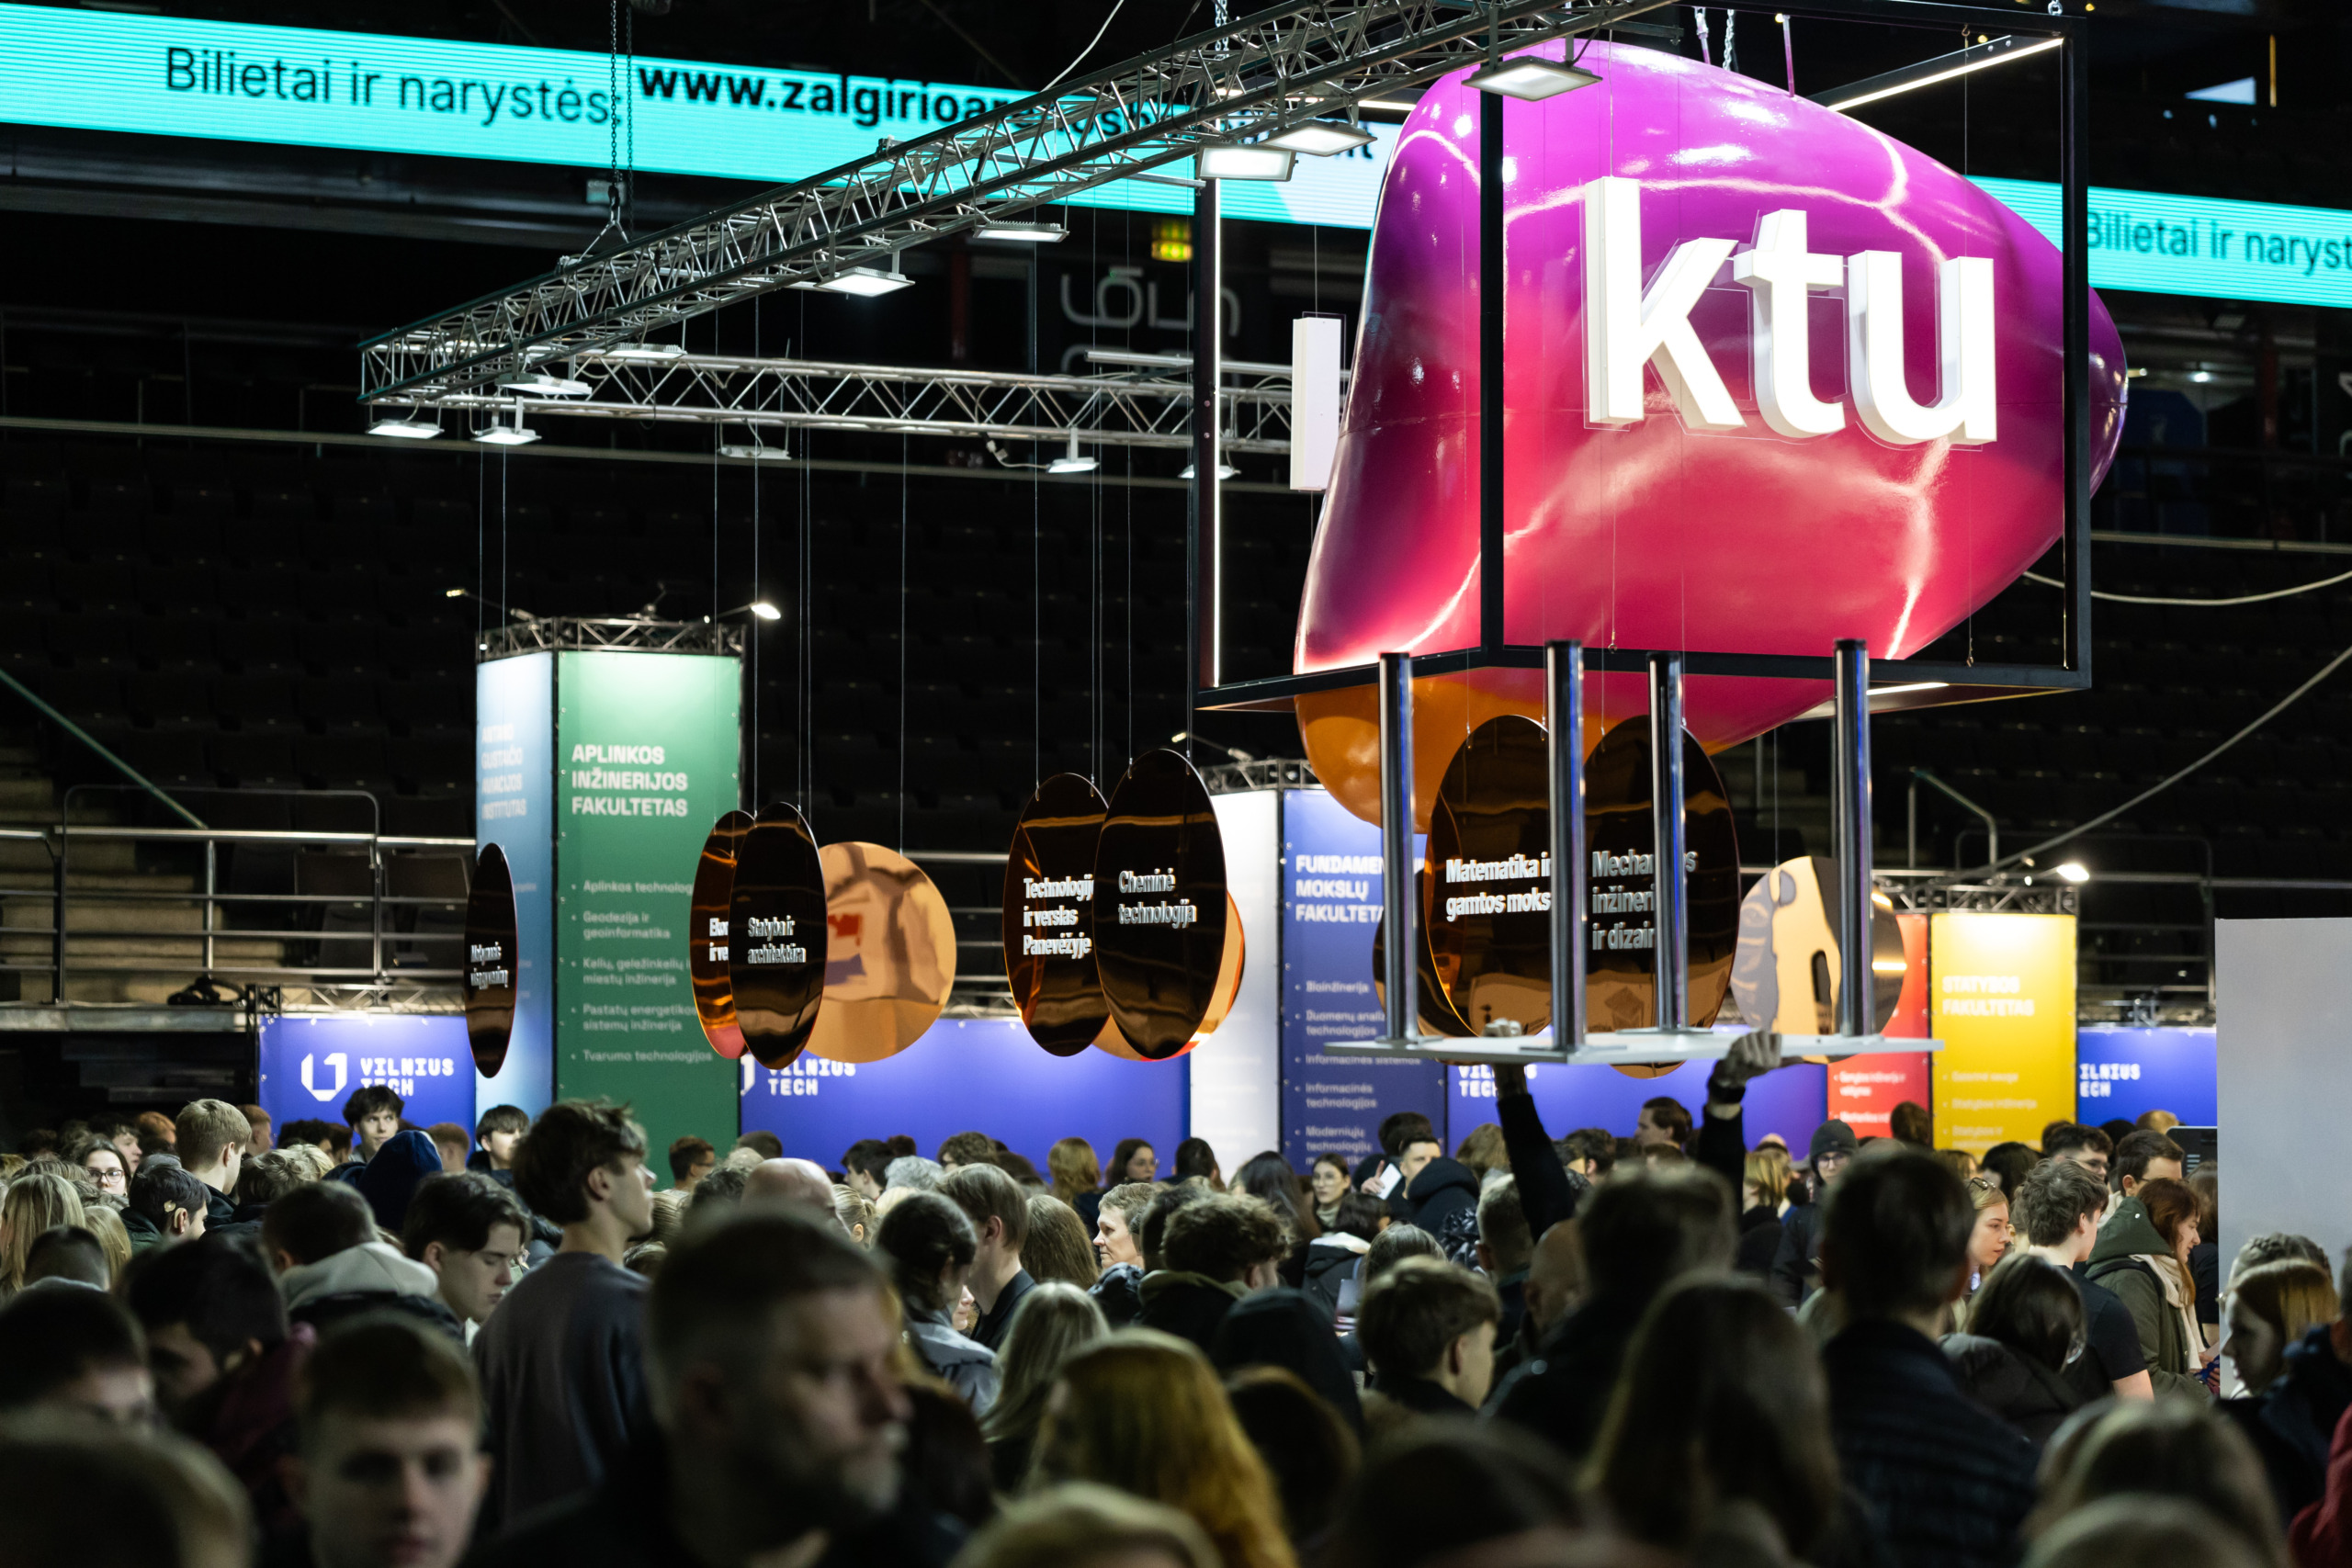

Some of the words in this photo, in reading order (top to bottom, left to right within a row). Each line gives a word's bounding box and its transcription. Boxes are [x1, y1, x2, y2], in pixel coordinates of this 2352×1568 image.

[167, 47, 330, 103] Bilietai
[349, 62, 380, 106] ir
[2211, 220, 2233, 259] ir
[1585, 175, 1997, 446] ktu
[571, 744, 664, 764] APLINKOS
[571, 766, 688, 791] INŽINERIJOS
[571, 796, 688, 817] FAKULTETAS
[1445, 853, 1541, 883] Matematika
[583, 880, 632, 895] Aplinkos
[635, 881, 694, 896] technolog
[1118, 867, 1177, 894] Cheminė
[1295, 879, 1370, 902] MOKSLŲ
[1445, 892, 1507, 922] gamtos
[1507, 886, 1552, 913] moks
[1592, 883, 1656, 914] inžineri
[582, 910, 639, 925] Geodezija
[1023, 905, 1034, 927] ir
[1034, 905, 1080, 927] verslas
[1118, 898, 1198, 930] technologija
[582, 927, 671, 941] geoinformatika
[748, 917, 786, 942] Statyba
[786, 915, 796, 936] ir
[1592, 922, 1607, 951] ir
[1023, 931, 1093, 960] Panevėžyje
[625, 974, 677, 987] inžinerija
[1941, 998, 2035, 1017] FAKULTETAS
[1306, 1025, 1377, 1038] technologijos
[360, 1057, 455, 1077] VILNIUS
[583, 1049, 632, 1062] Tvarumo
[635, 1050, 713, 1064] technologijos
[2079, 1063, 2142, 1080] ILNIUS
[767, 1077, 820, 1096] TECH
[2079, 1080, 2112, 1098] ECH
[1306, 1098, 1377, 1111] technologijos
